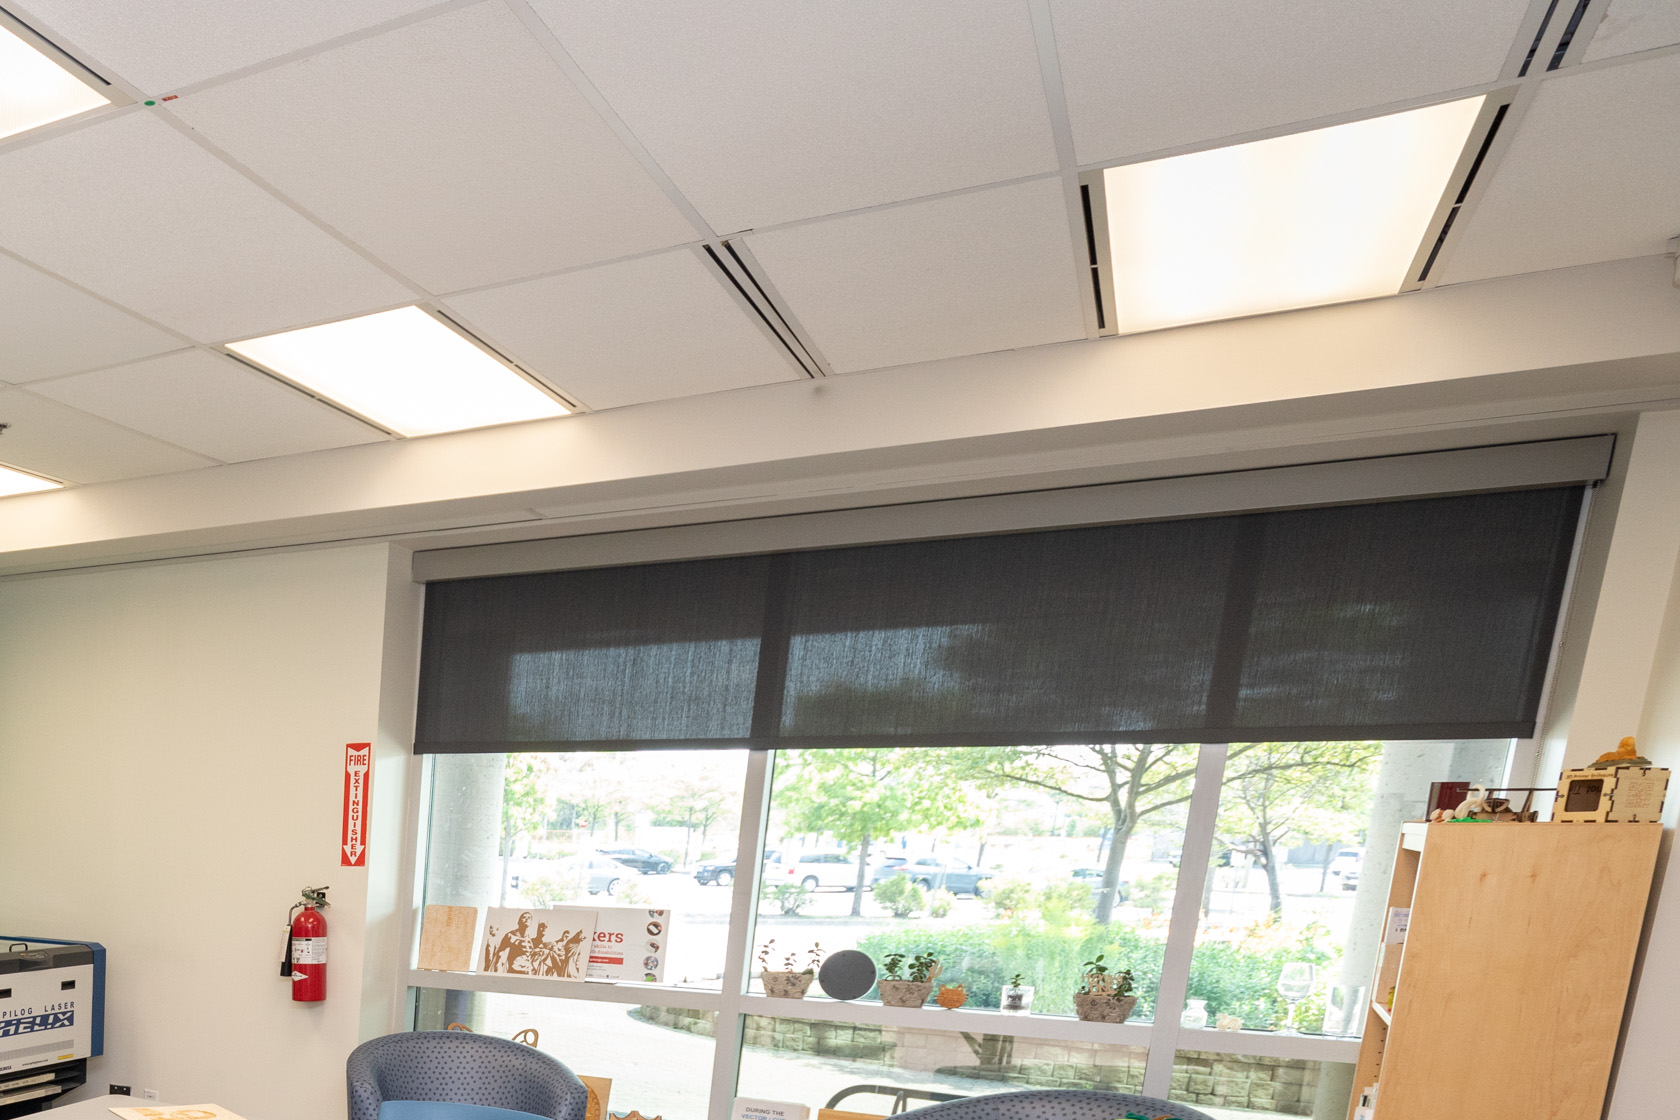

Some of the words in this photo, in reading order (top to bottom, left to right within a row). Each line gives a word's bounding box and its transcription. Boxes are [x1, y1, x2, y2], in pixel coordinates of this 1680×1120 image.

[349, 754, 367, 766] FIRE
[350, 770, 361, 858] EXTINGUISHER
[44, 1001, 75, 1012] LASER
[746, 1107, 770, 1115] DURING
